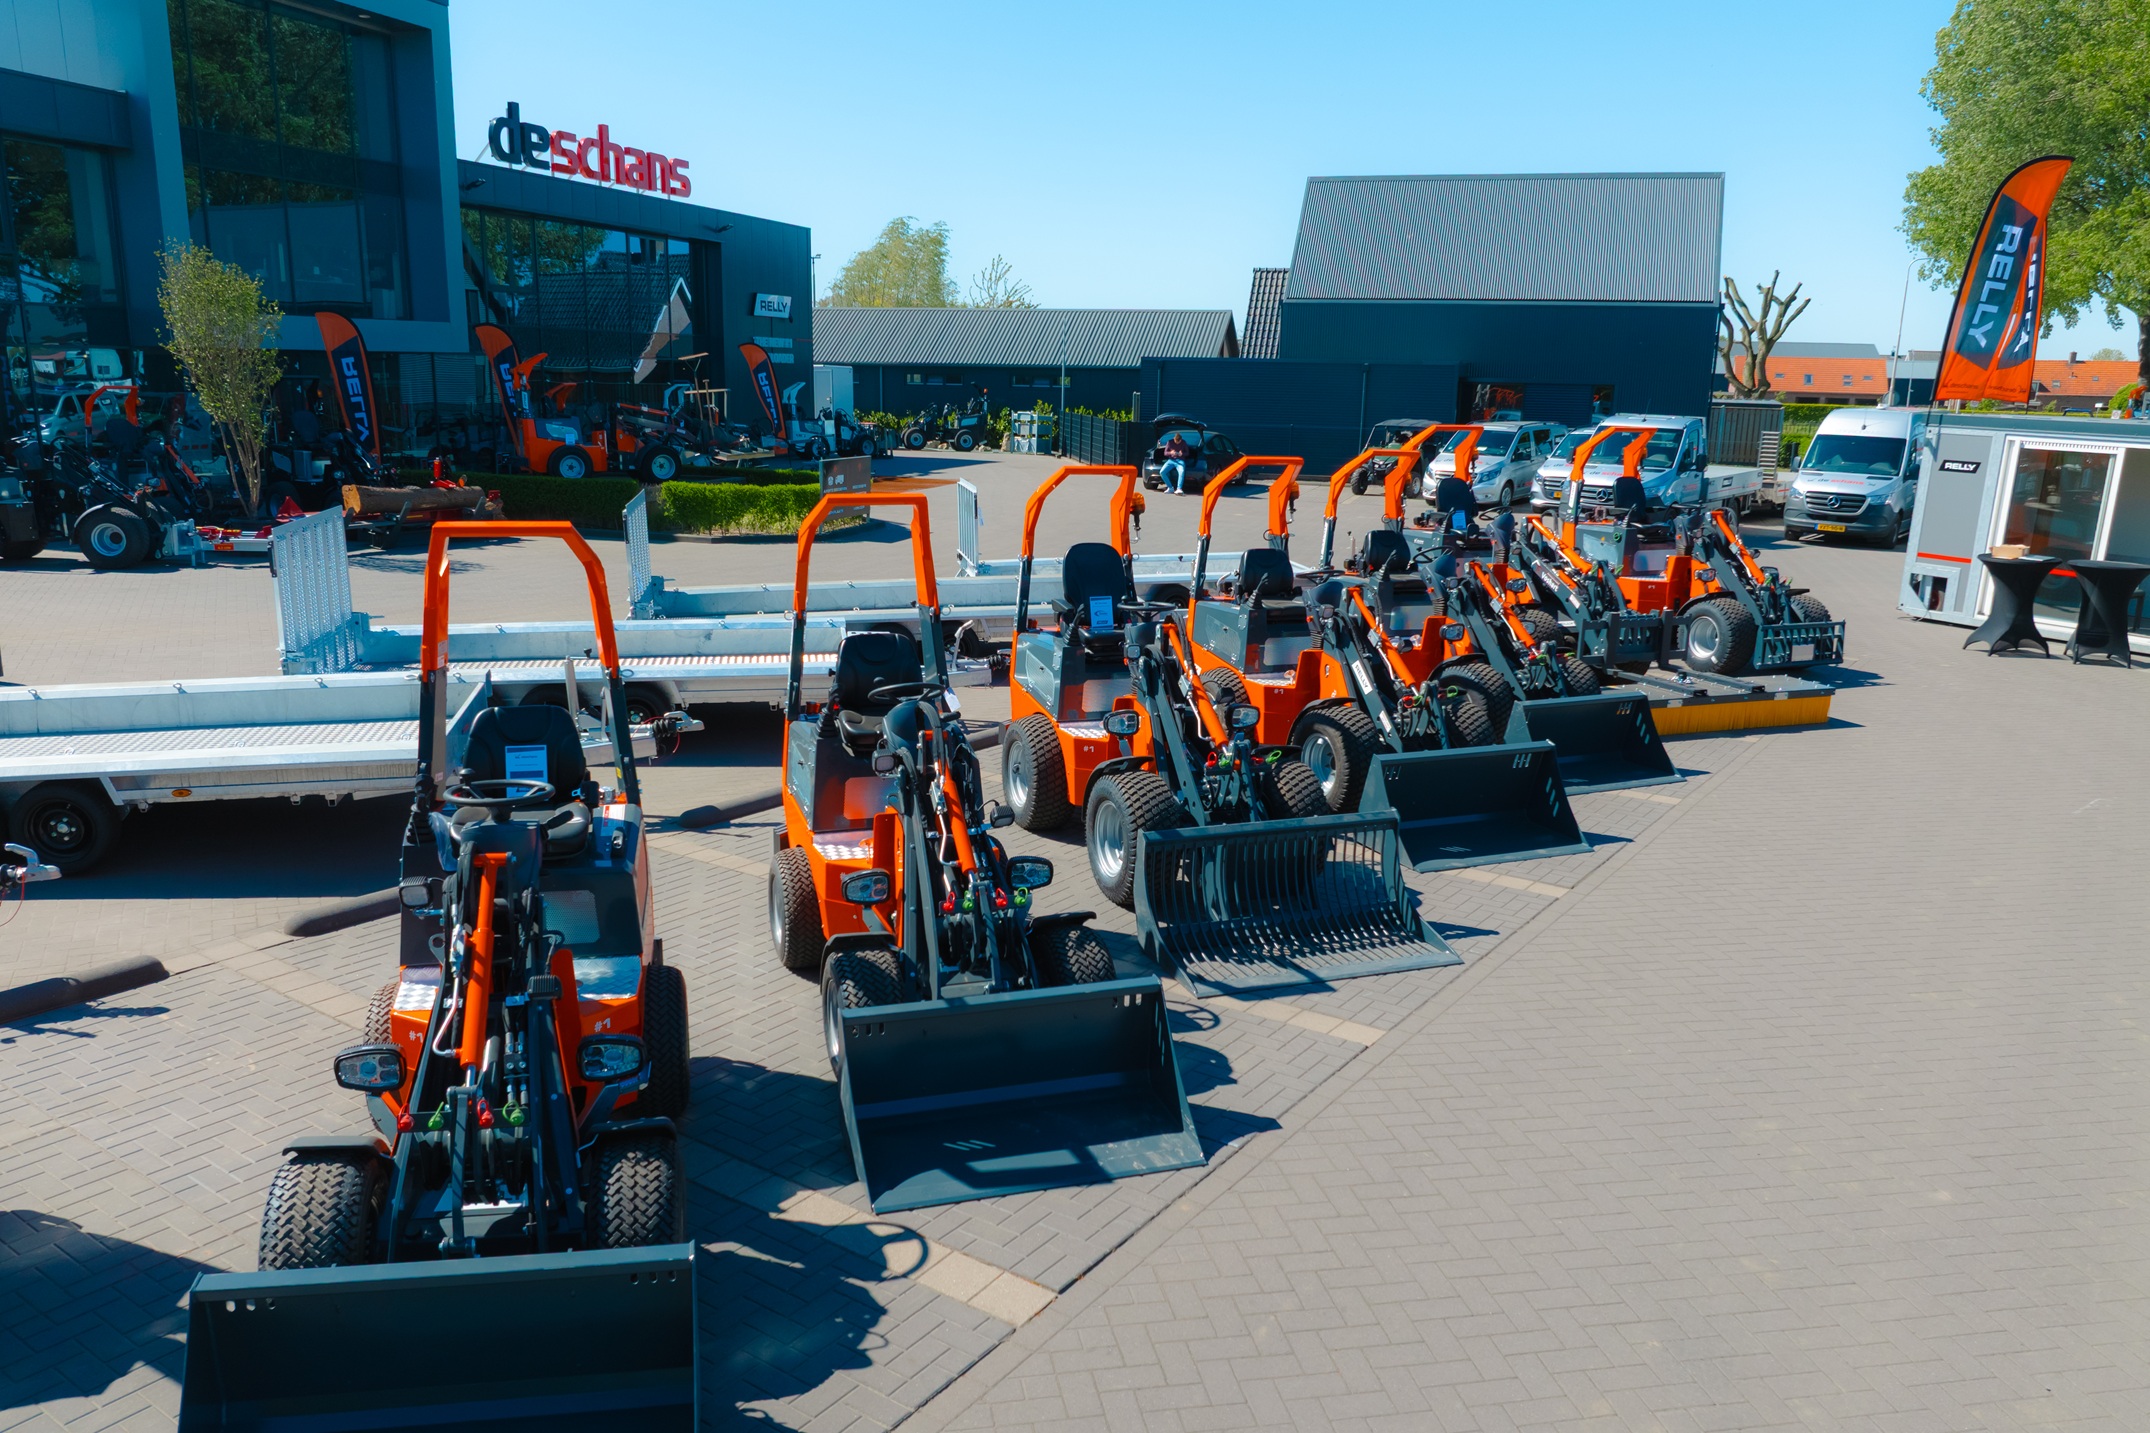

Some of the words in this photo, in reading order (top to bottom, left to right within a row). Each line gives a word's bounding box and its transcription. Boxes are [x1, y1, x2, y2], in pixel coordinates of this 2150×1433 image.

[1968, 224, 2023, 349] RELLY
[760, 300, 788, 313] RELLY
[1944, 462, 1976, 471] RELLY
[1083, 745, 1095, 753] #1
[593, 1018, 611, 1032] #1
[408, 1029, 424, 1043] #1
